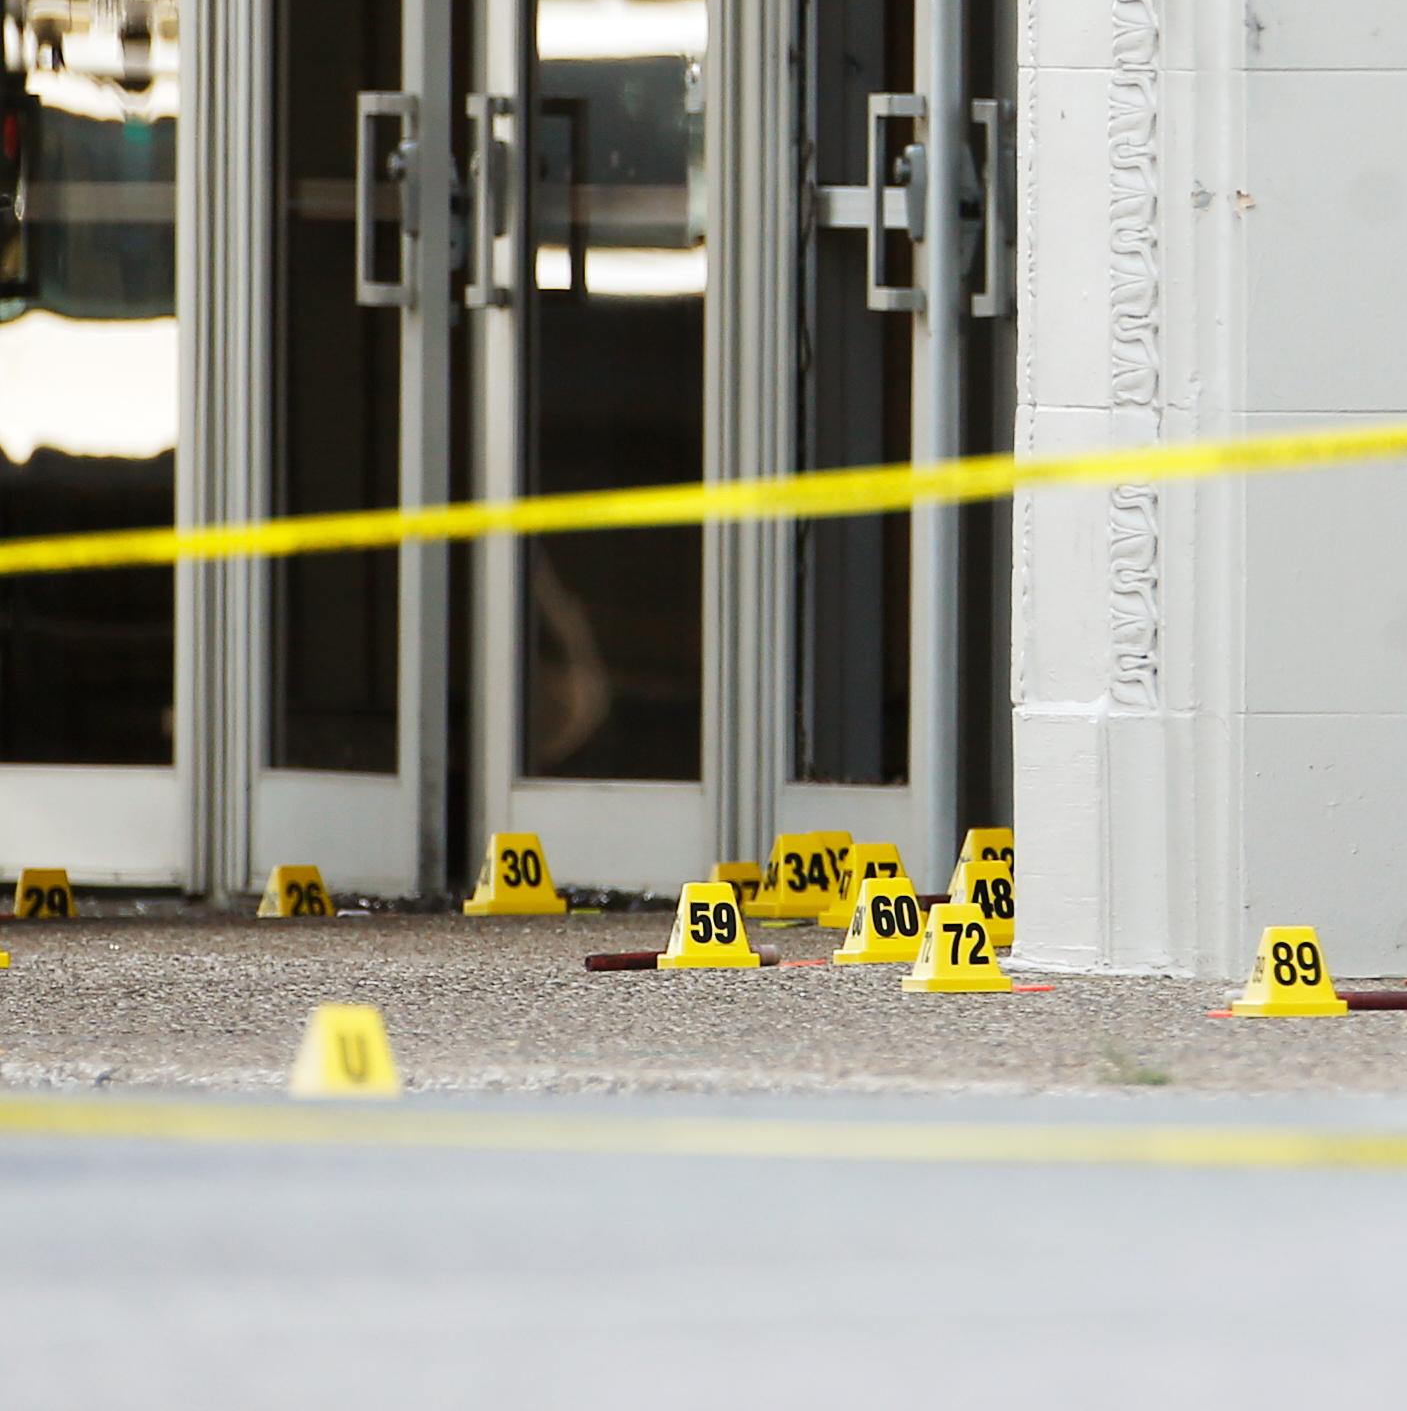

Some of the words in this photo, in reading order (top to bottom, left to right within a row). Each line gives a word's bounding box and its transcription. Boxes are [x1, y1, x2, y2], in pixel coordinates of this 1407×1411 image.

[501, 849, 541, 887] 30
[784, 852, 829, 893] 34
[871, 895, 918, 938] 60
[972, 878, 1014, 919] 48
[690, 902, 737, 944] 59
[943, 923, 989, 965] 72
[1272, 941, 1322, 986] 89
[337, 1032, 370, 1084] U
